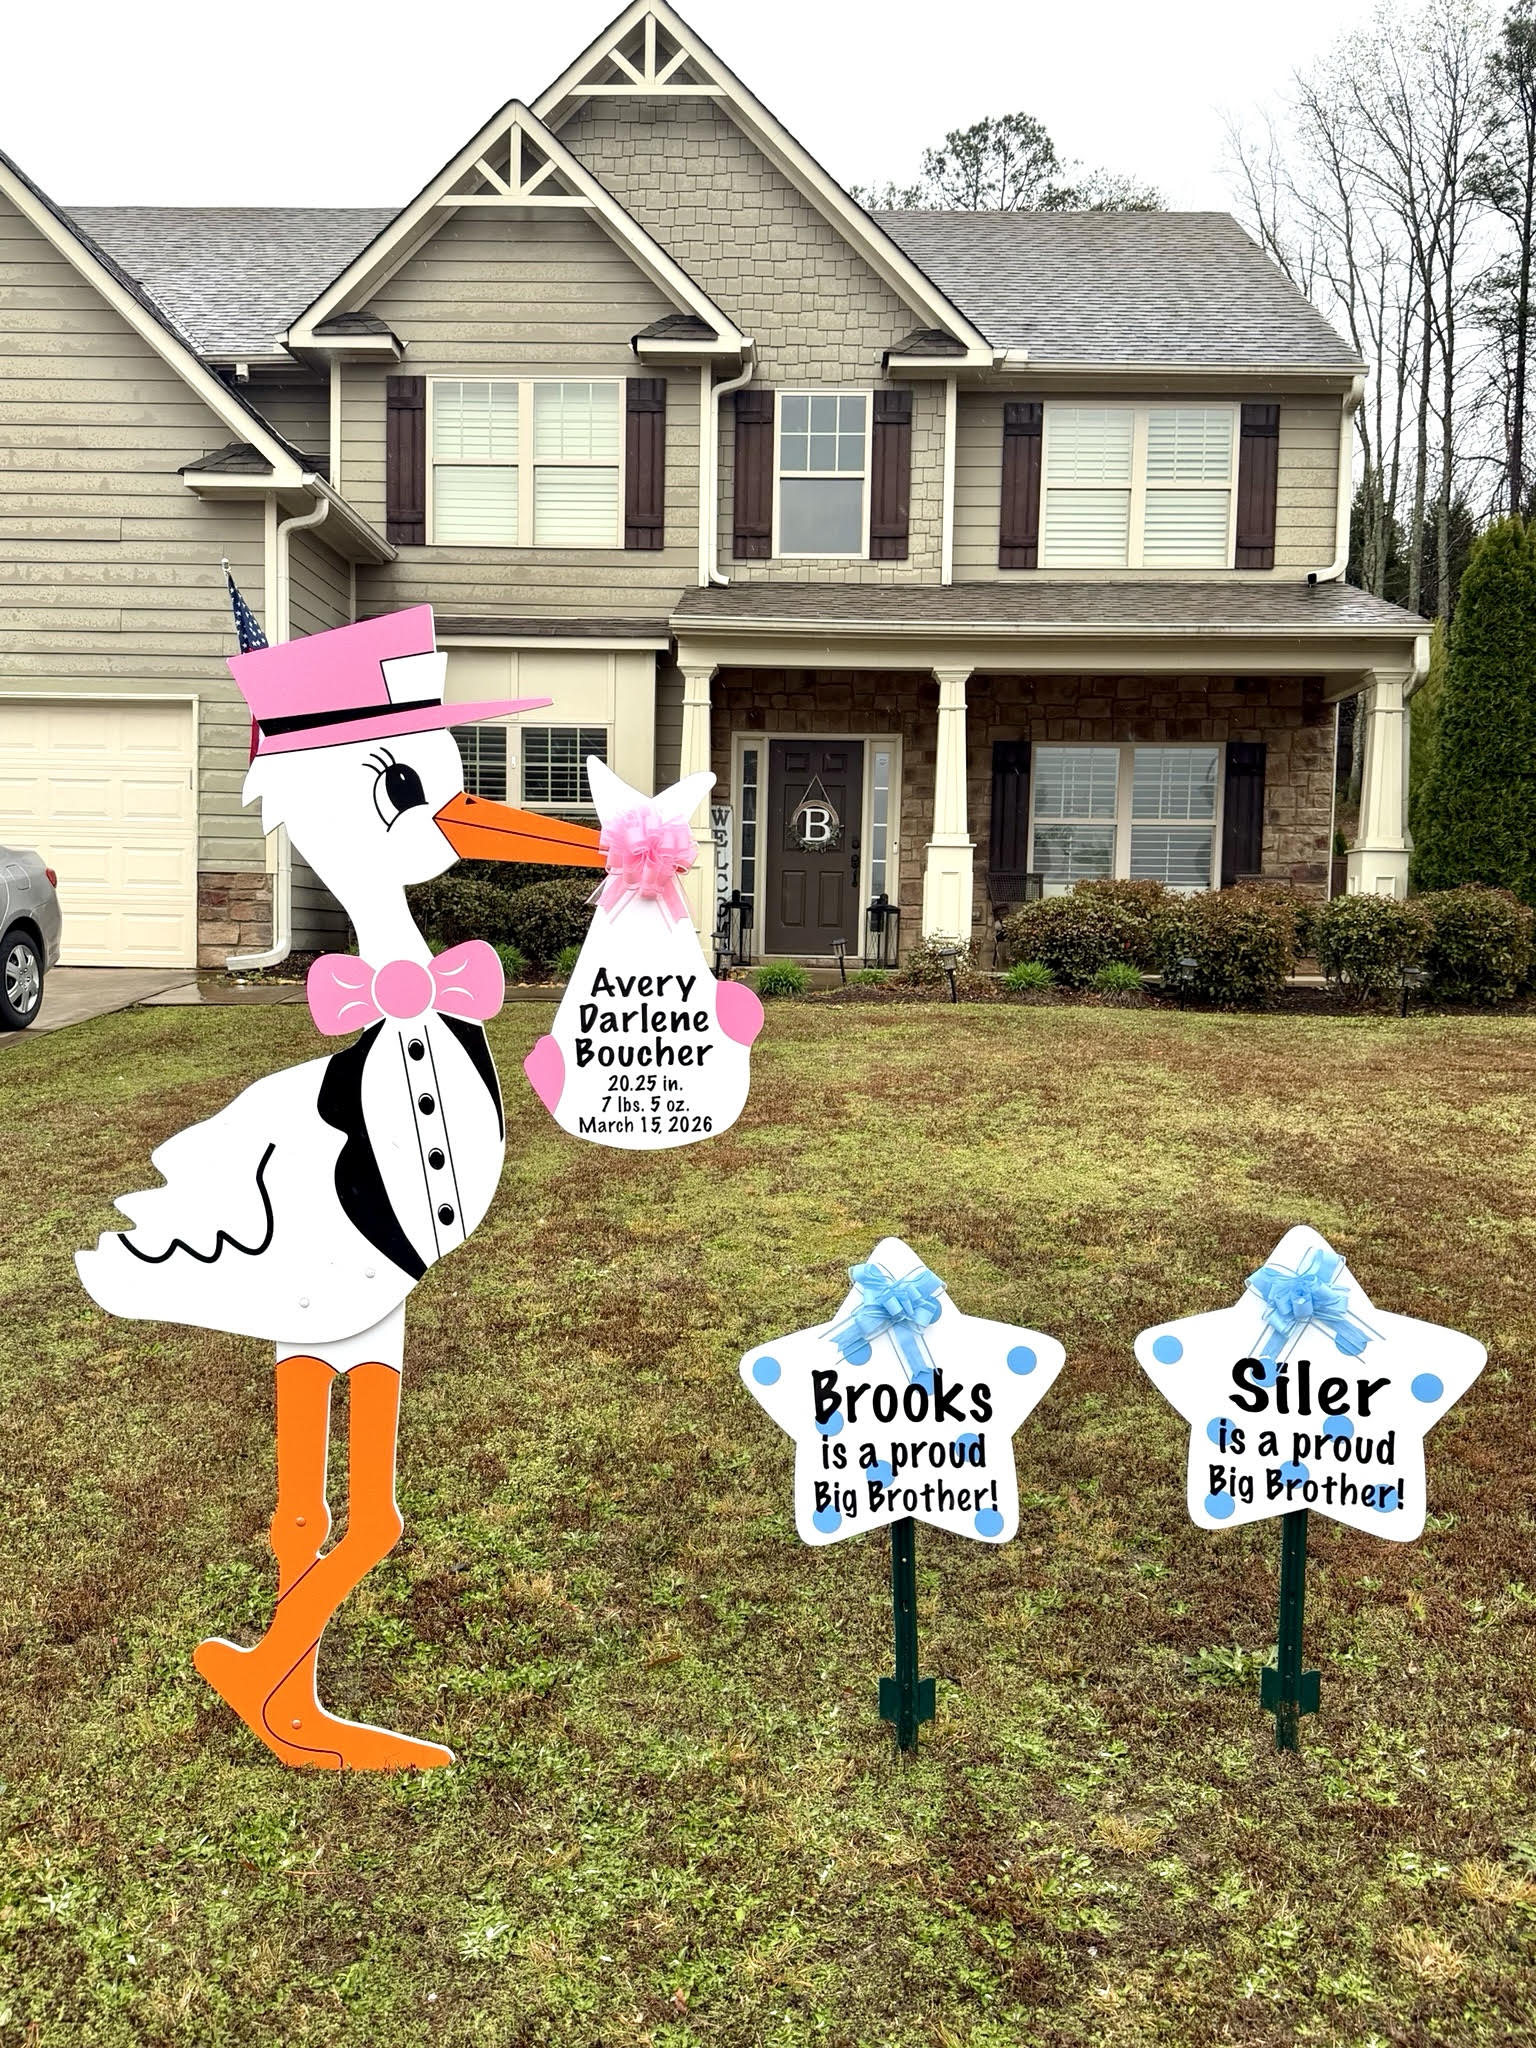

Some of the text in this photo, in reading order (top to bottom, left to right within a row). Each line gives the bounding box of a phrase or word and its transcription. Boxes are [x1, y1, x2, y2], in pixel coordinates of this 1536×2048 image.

[802, 808, 831, 841] B
[591, 967, 697, 1003] Avery
[580, 1003, 709, 1034] Darlene
[576, 1036, 714, 1068] Boucher
[608, 1074, 683, 1092] 20.25 in.
[602, 1095, 690, 1113] 7 lbs. 5 oz.
[579, 1116, 713, 1136] March 15, 2026
[811, 1367, 993, 1425] Brooks
[1229, 1357, 1392, 1418] Siler
[822, 1432, 987, 1478] is a proud
[1219, 1418, 1396, 1467] is a proud
[813, 1478, 998, 1519] Big Brother!
[1208, 1463, 1405, 1510] Big Brother!
